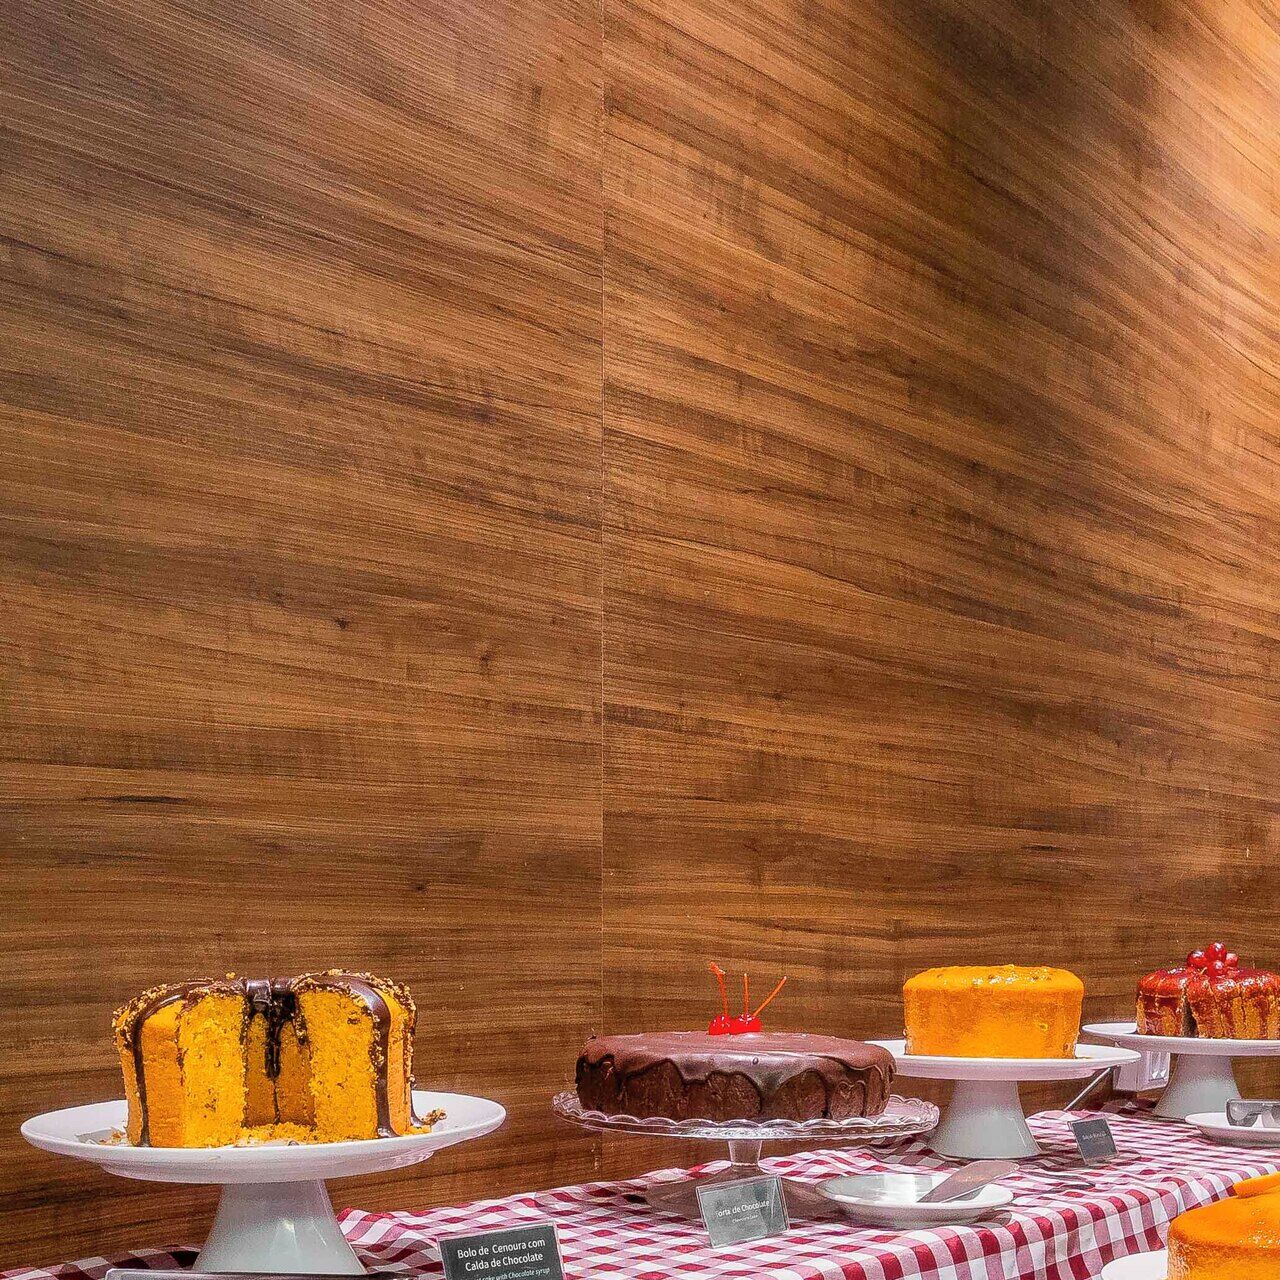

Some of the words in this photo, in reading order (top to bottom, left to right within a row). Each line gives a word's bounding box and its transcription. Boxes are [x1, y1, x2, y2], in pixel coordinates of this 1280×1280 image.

[457, 1247, 477, 1259] Bolo
[478, 1244, 489, 1256] de
[492, 1242, 527, 1254] Cenoura
[528, 1238, 546, 1249] com
[465, 1260, 490, 1272] Calda
[491, 1258, 501, 1268] de
[502, 1252, 544, 1266] Chocolate
[496, 1273, 508, 1280] with
[508, 1269, 536, 1280] Chocolate
[536, 1267, 551, 1277] syrup
